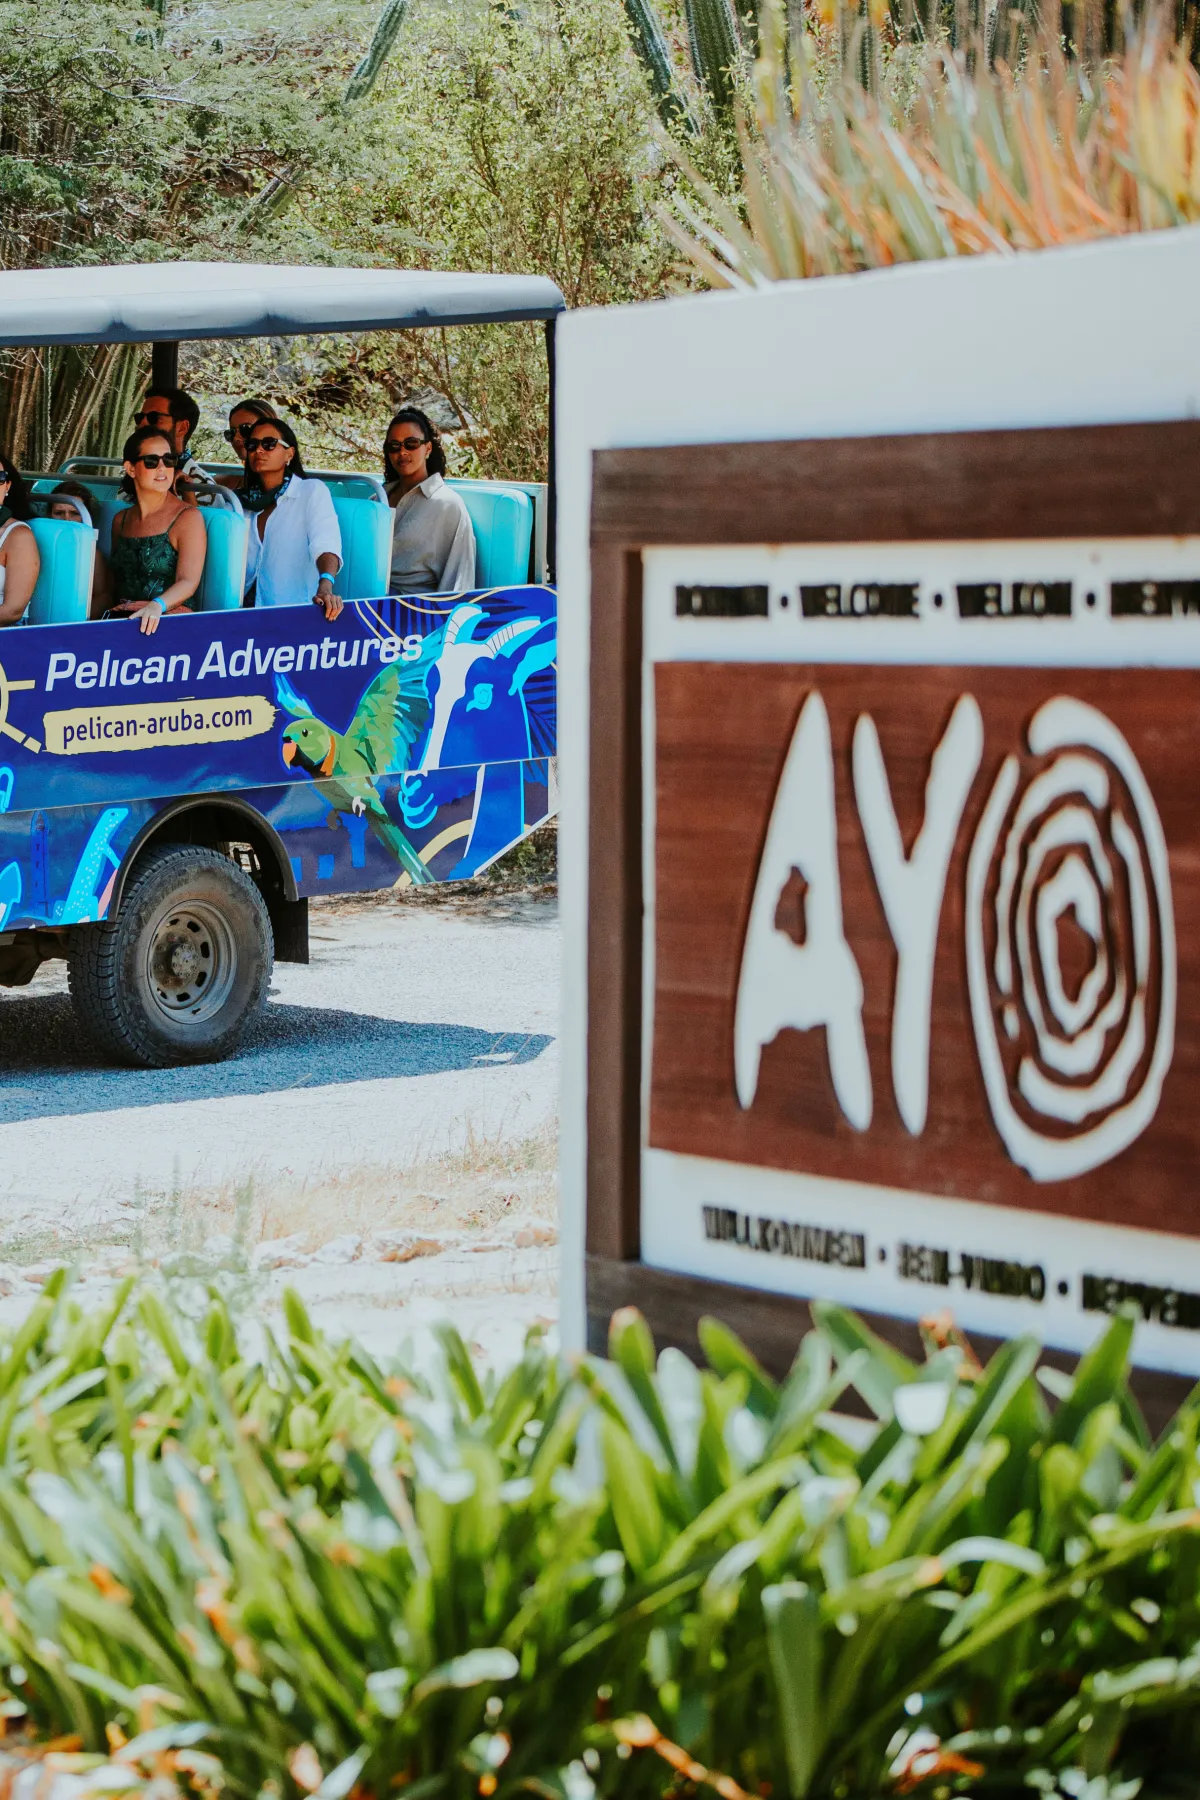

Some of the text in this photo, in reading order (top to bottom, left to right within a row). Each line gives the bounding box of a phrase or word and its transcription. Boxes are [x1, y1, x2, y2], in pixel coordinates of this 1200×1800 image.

[45, 633, 423, 692] Pelican Adventures
[62, 708, 253, 749] pelican-aruba.com
[734, 690, 1178, 1183] AYO
